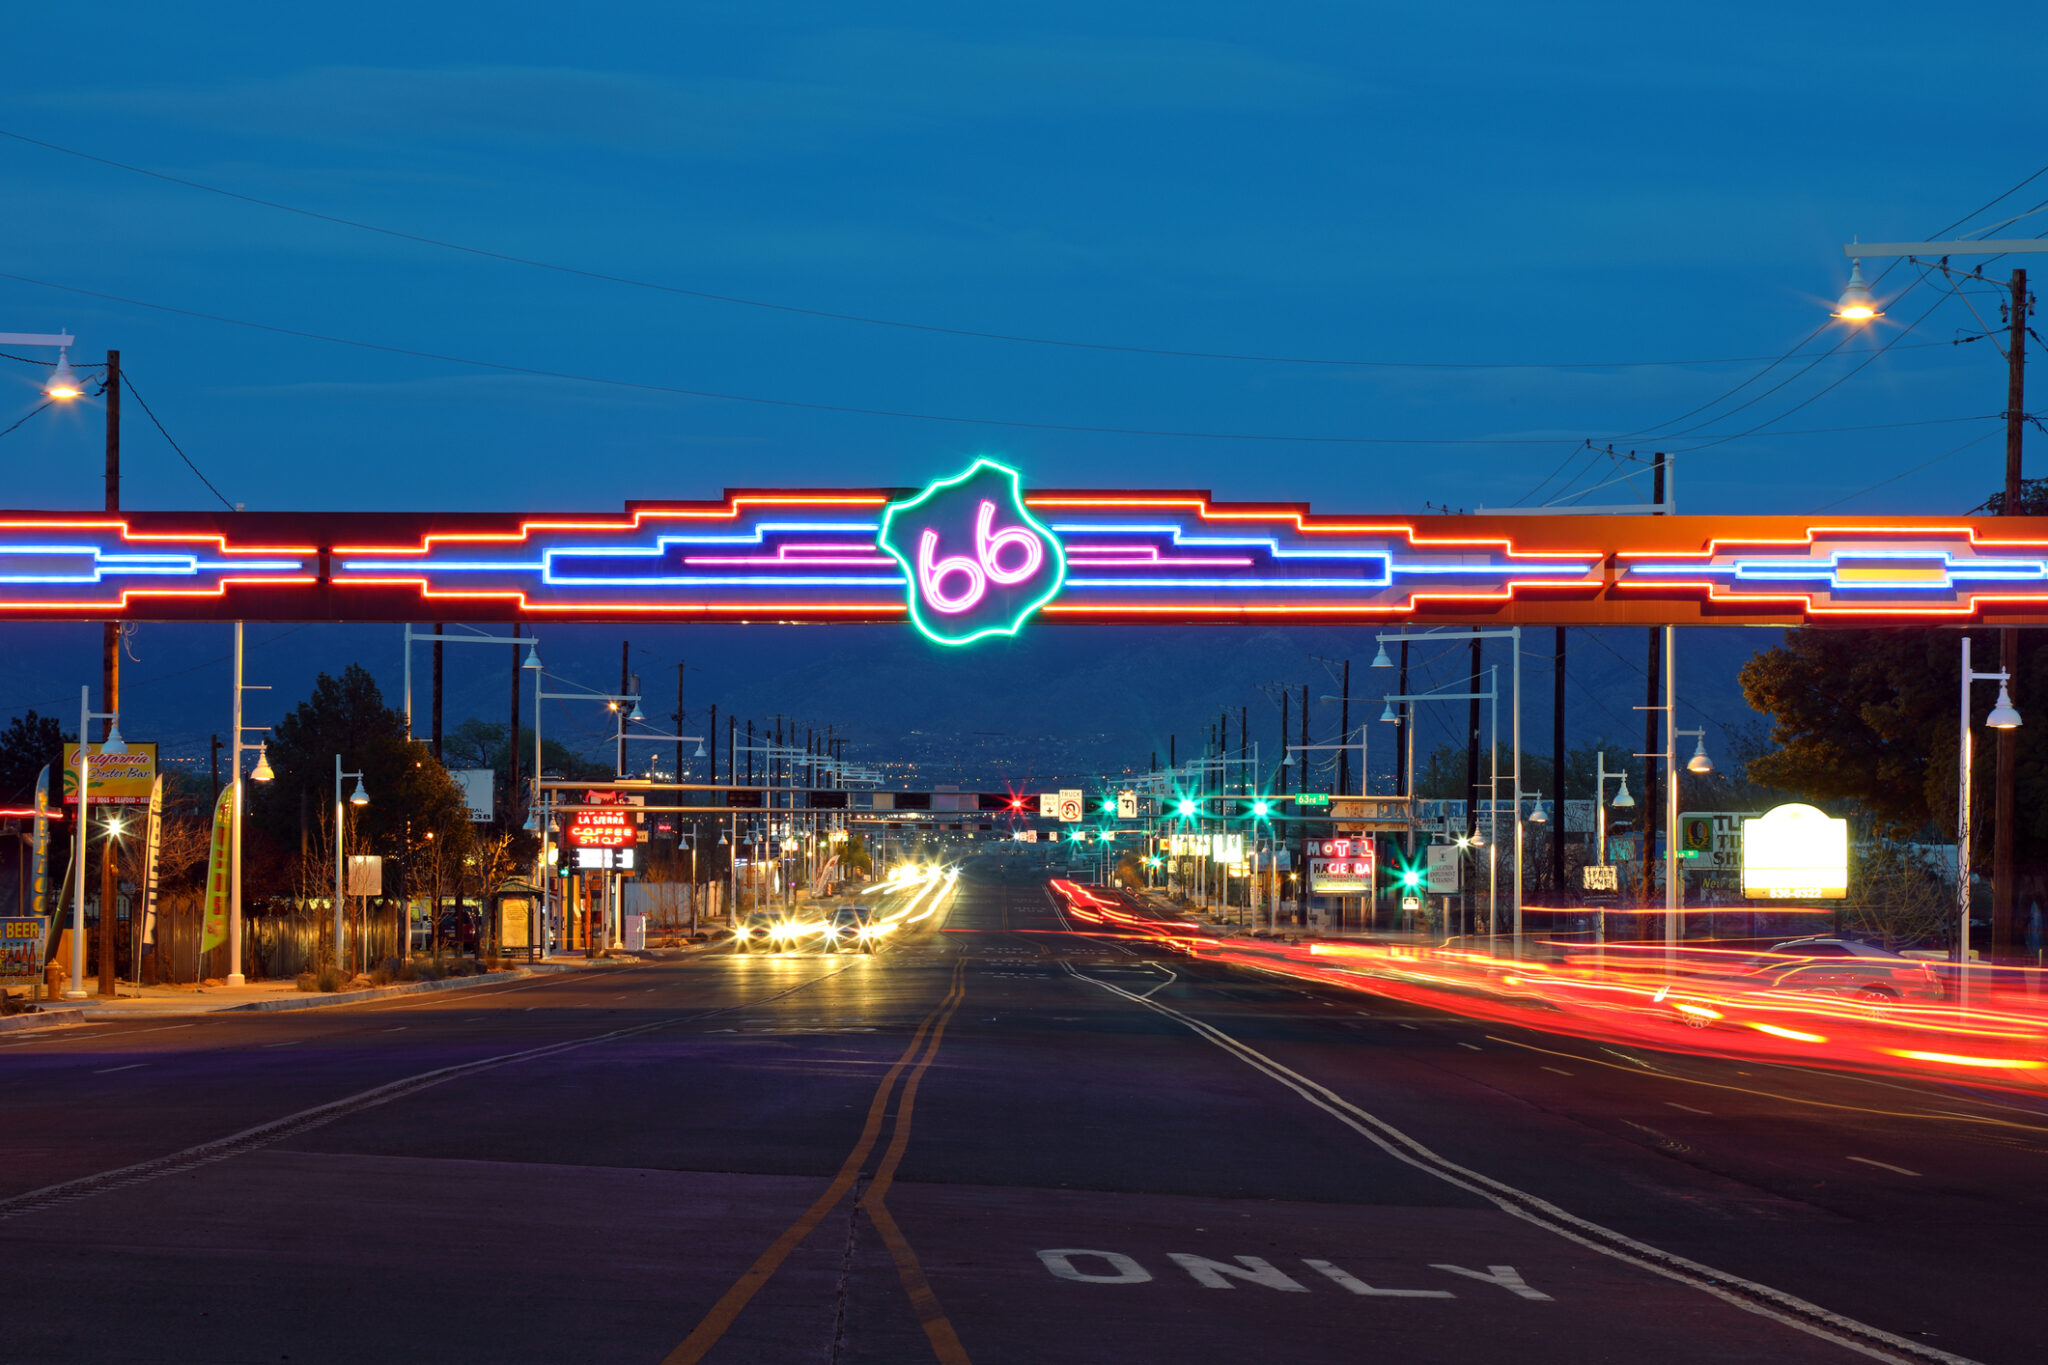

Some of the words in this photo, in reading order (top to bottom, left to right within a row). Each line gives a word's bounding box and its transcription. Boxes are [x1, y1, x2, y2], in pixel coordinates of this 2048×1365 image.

[920, 500, 1042, 613] 66
[89, 767, 125, 781] Oyster
[127, 767, 150, 779] Bar
[1298, 795, 1316, 804] 63rd
[578, 816, 590, 824] LA
[592, 816, 624, 825] SIERRA
[571, 827, 632, 837] COFFEE
[579, 837, 623, 845] SHOP
[1306, 840, 1374, 857] MOTEL
[1313, 863, 1370, 874] HACIENDA
[5, 921, 39, 939] BEER
[1036, 1249, 1557, 1301] ONLY
